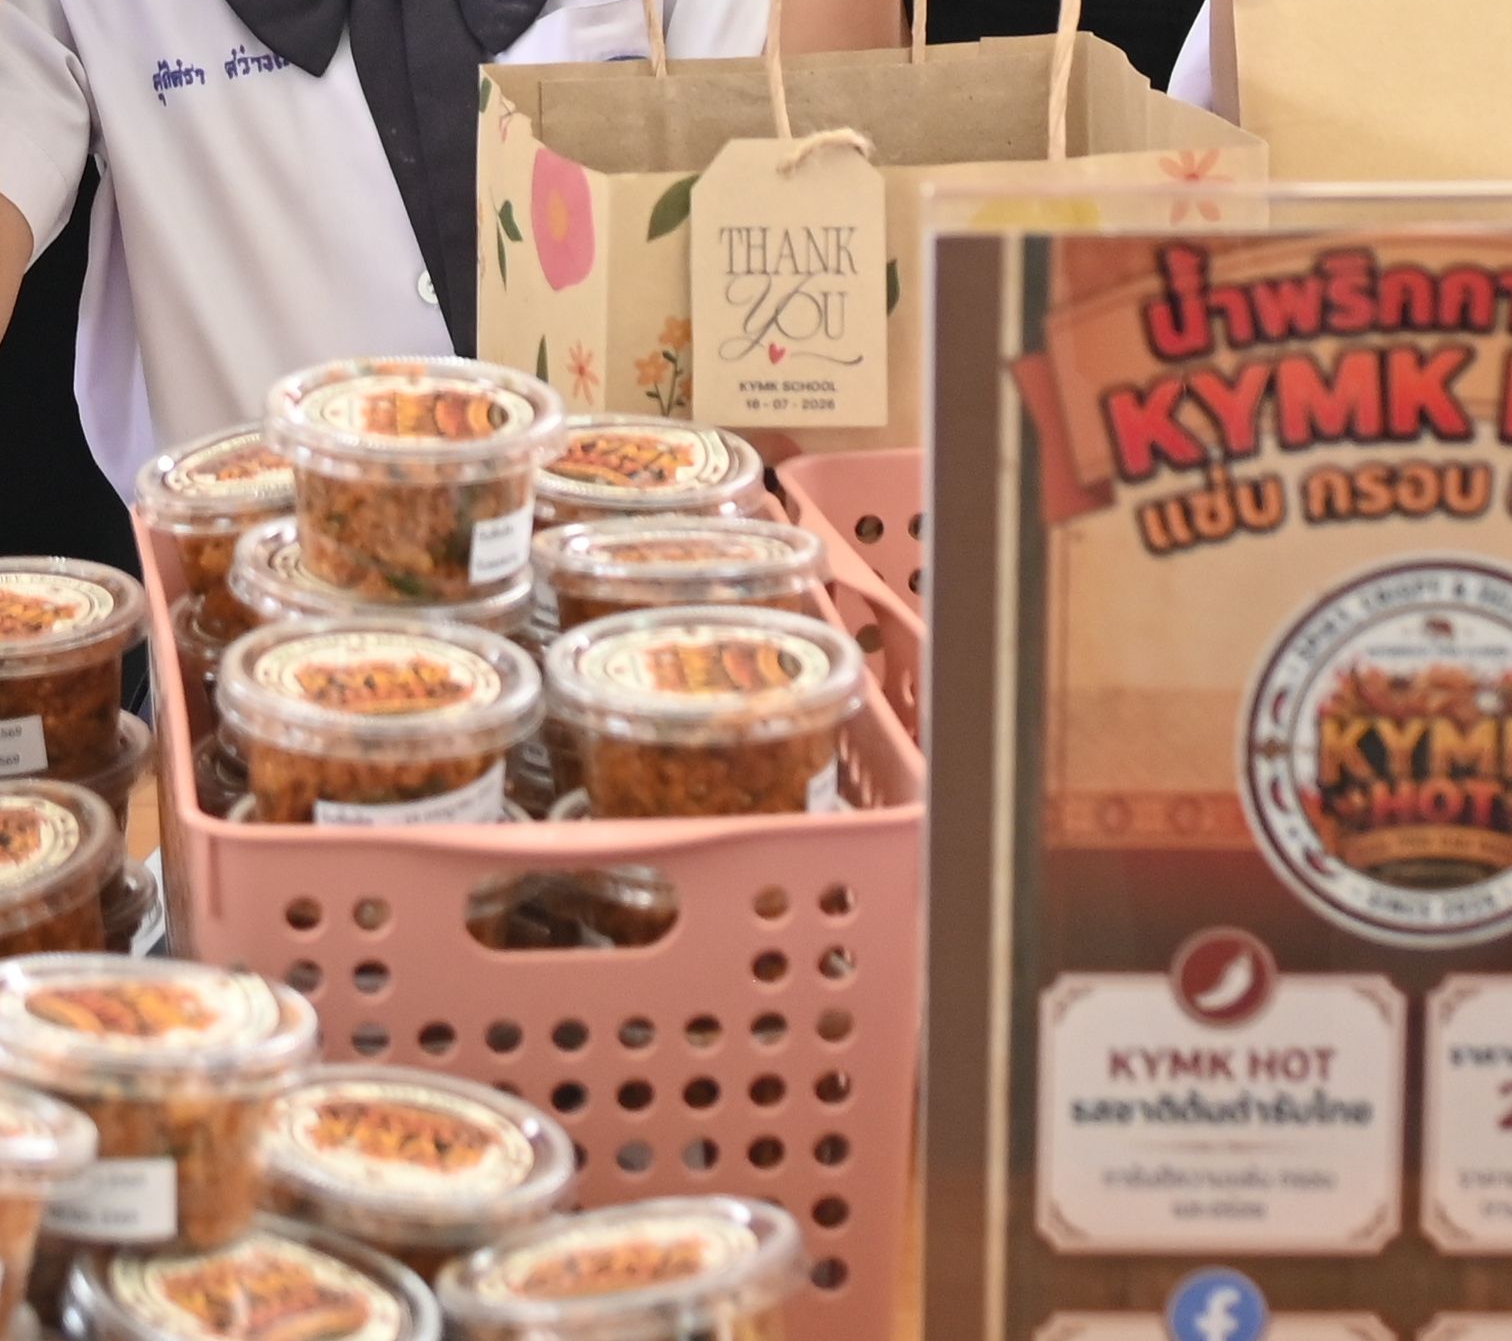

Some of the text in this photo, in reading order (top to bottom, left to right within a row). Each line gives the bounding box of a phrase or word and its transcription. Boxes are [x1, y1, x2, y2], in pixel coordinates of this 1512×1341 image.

[719, 227, 858, 277] THANK
[718, 272, 848, 363] YOU
[739, 380, 836, 391] KYMK SCHOOL
[772, 398, 788, 409] 07
[1100, 342, 1476, 482] KYMK
[1137, 463, 1288, 557] แซ่บ
[1301, 456, 1496, 530] กรอบ
[1370, 777, 1504, 827] HOT
[1107, 1046, 1339, 1084] KYMK HOT
